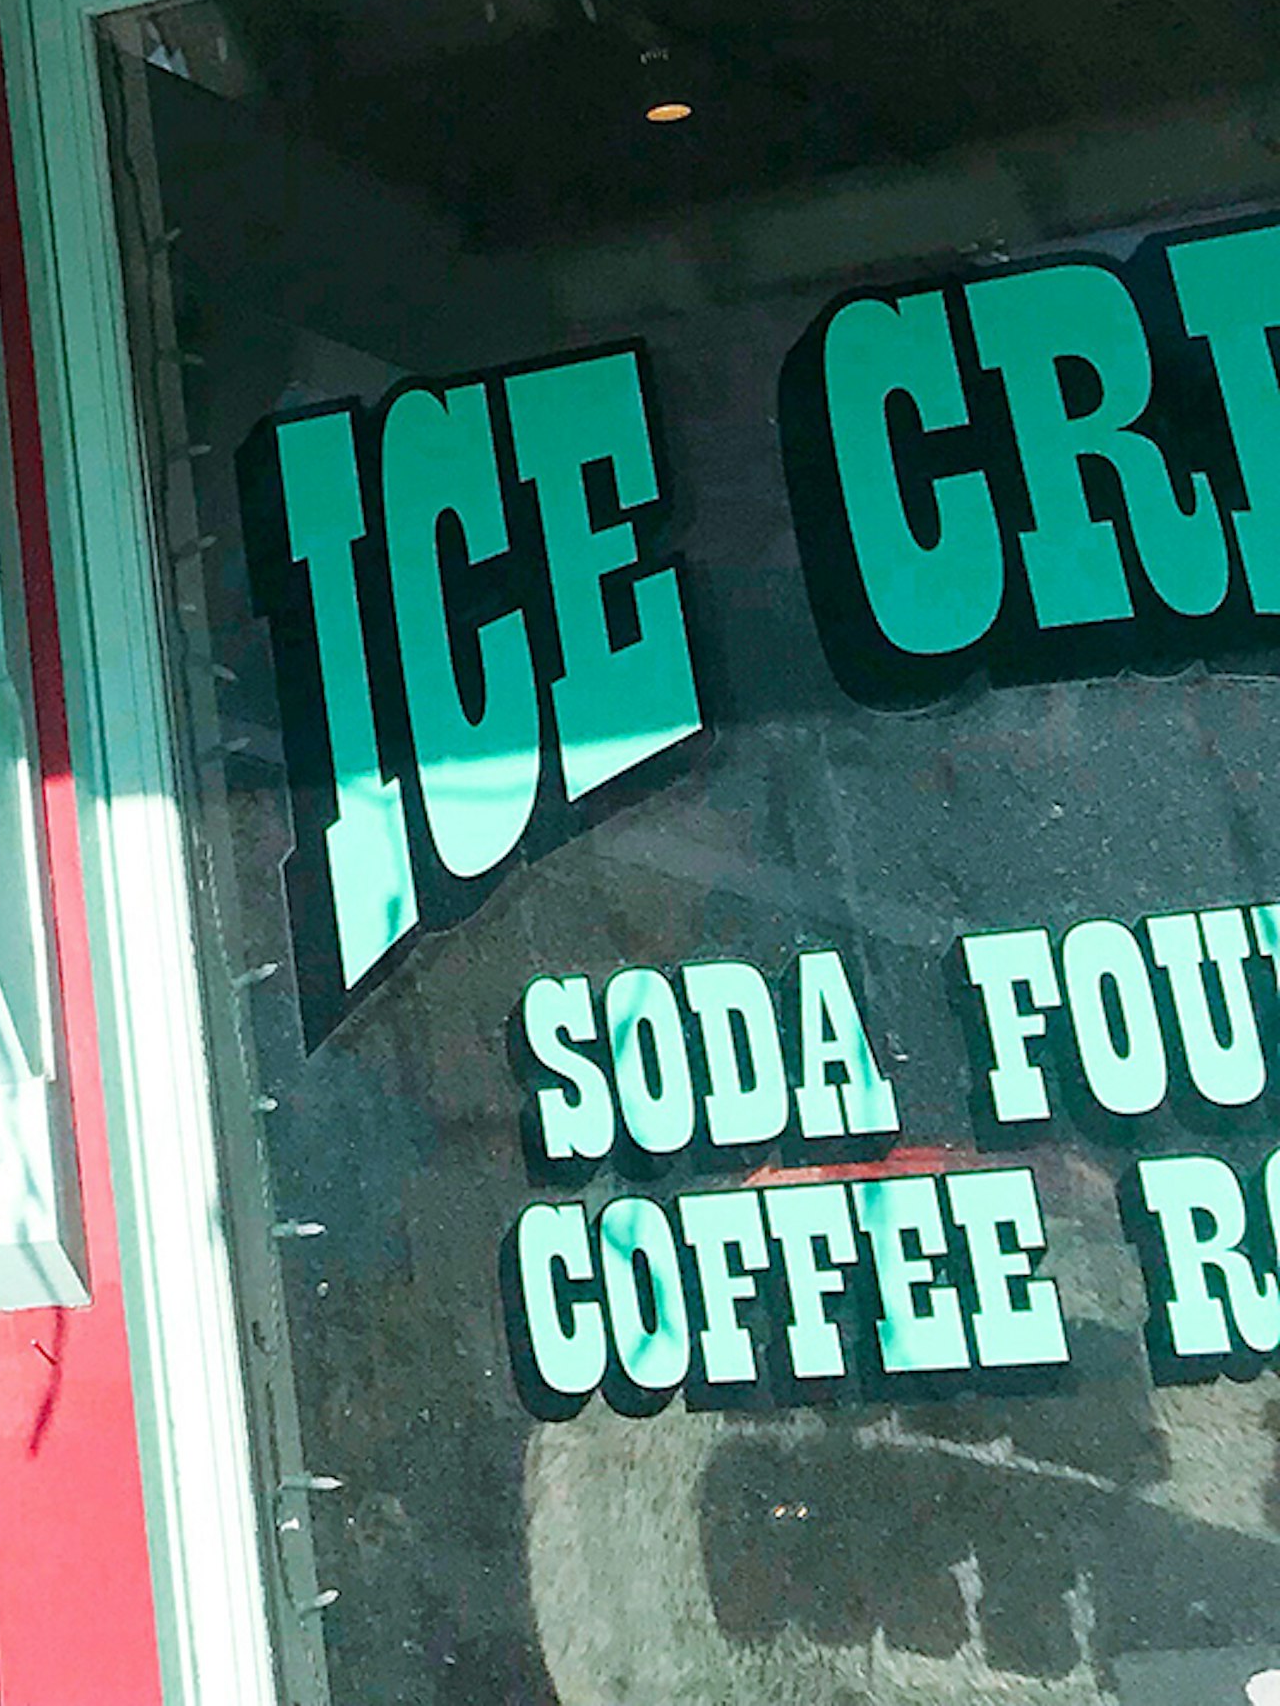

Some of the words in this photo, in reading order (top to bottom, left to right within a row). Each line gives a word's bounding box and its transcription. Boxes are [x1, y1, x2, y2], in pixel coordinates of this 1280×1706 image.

[276, 351, 703, 991] ICE
[524, 950, 900, 1158] SODA
[962, 902, 1280, 1122] FOU
[517, 1169, 1065, 1394] COFFEE
[1137, 1147, 1280, 1356] R
